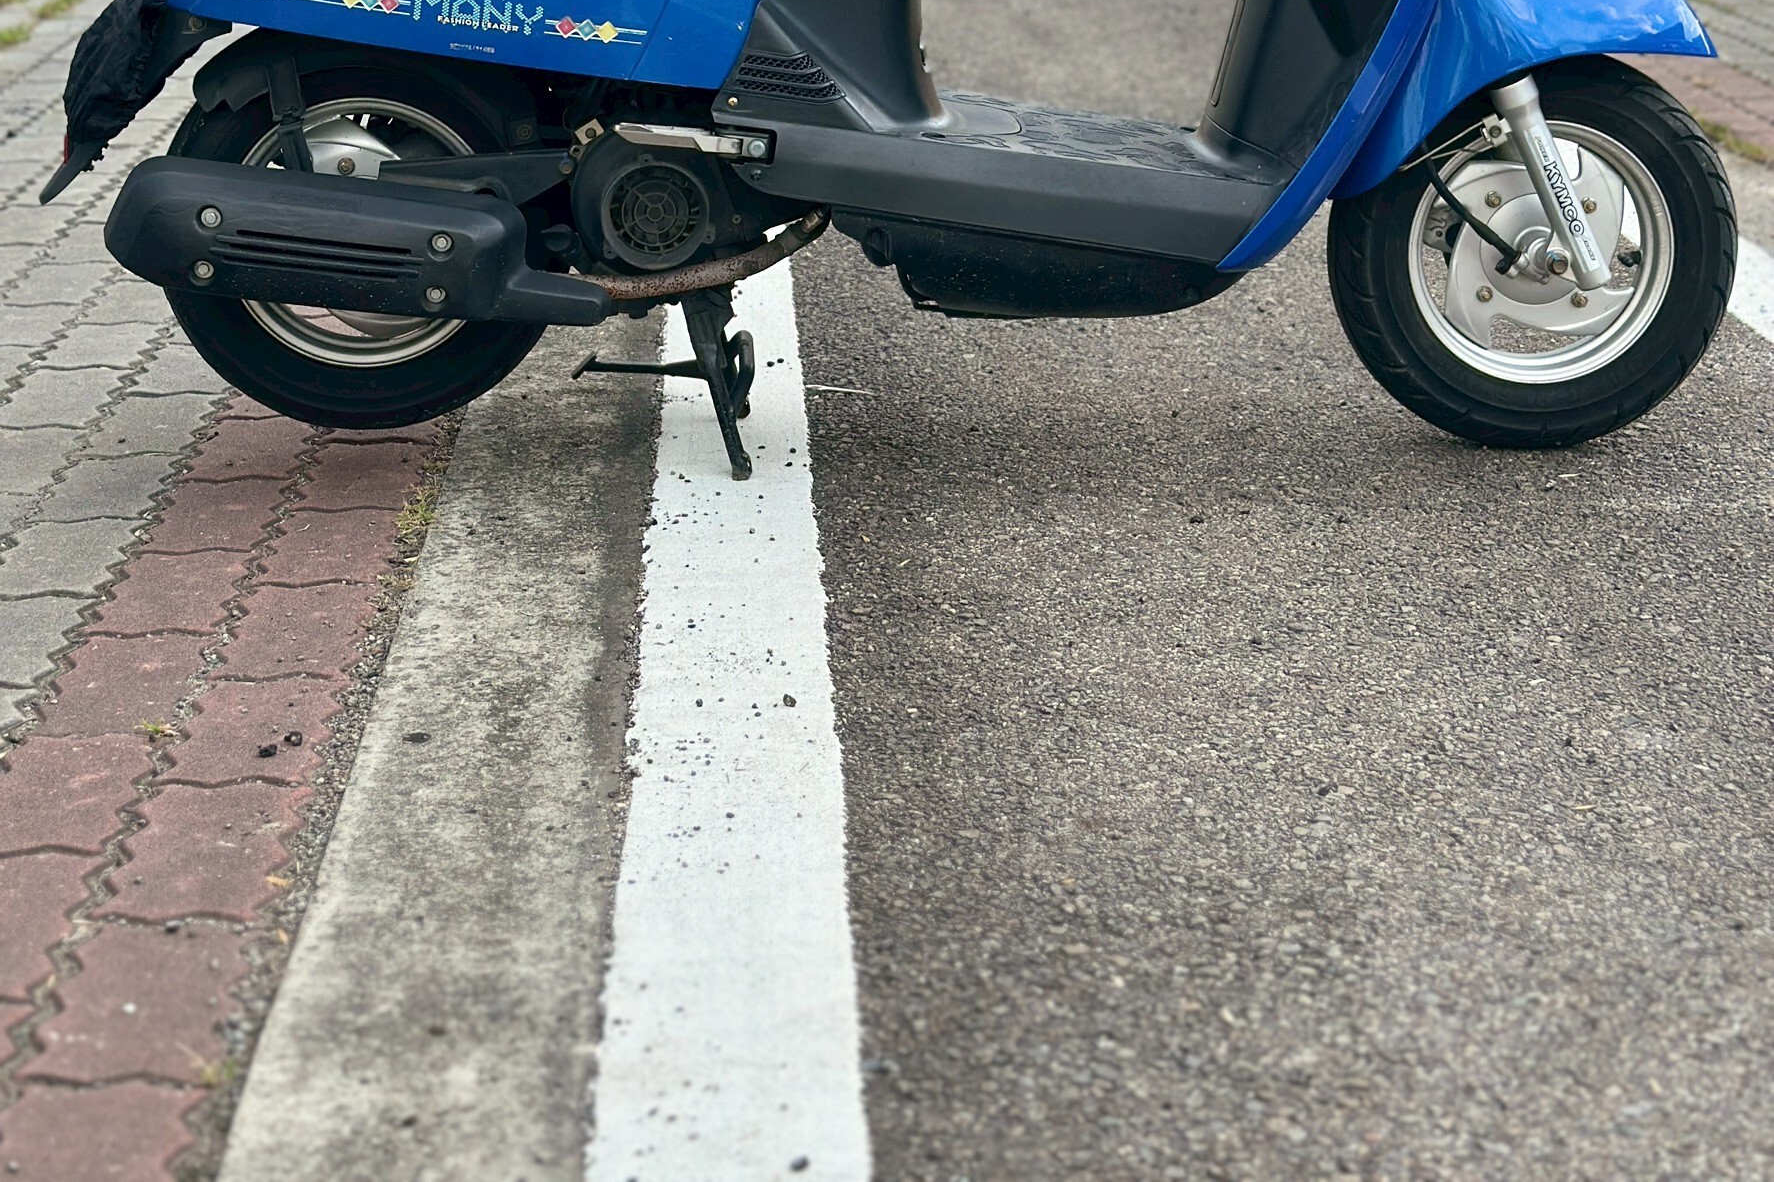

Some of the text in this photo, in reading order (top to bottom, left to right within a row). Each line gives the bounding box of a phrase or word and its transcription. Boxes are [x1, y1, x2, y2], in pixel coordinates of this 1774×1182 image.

[437, 15, 520, 32] FASHION LEADER
[1543, 160, 1585, 238] KYMCO
